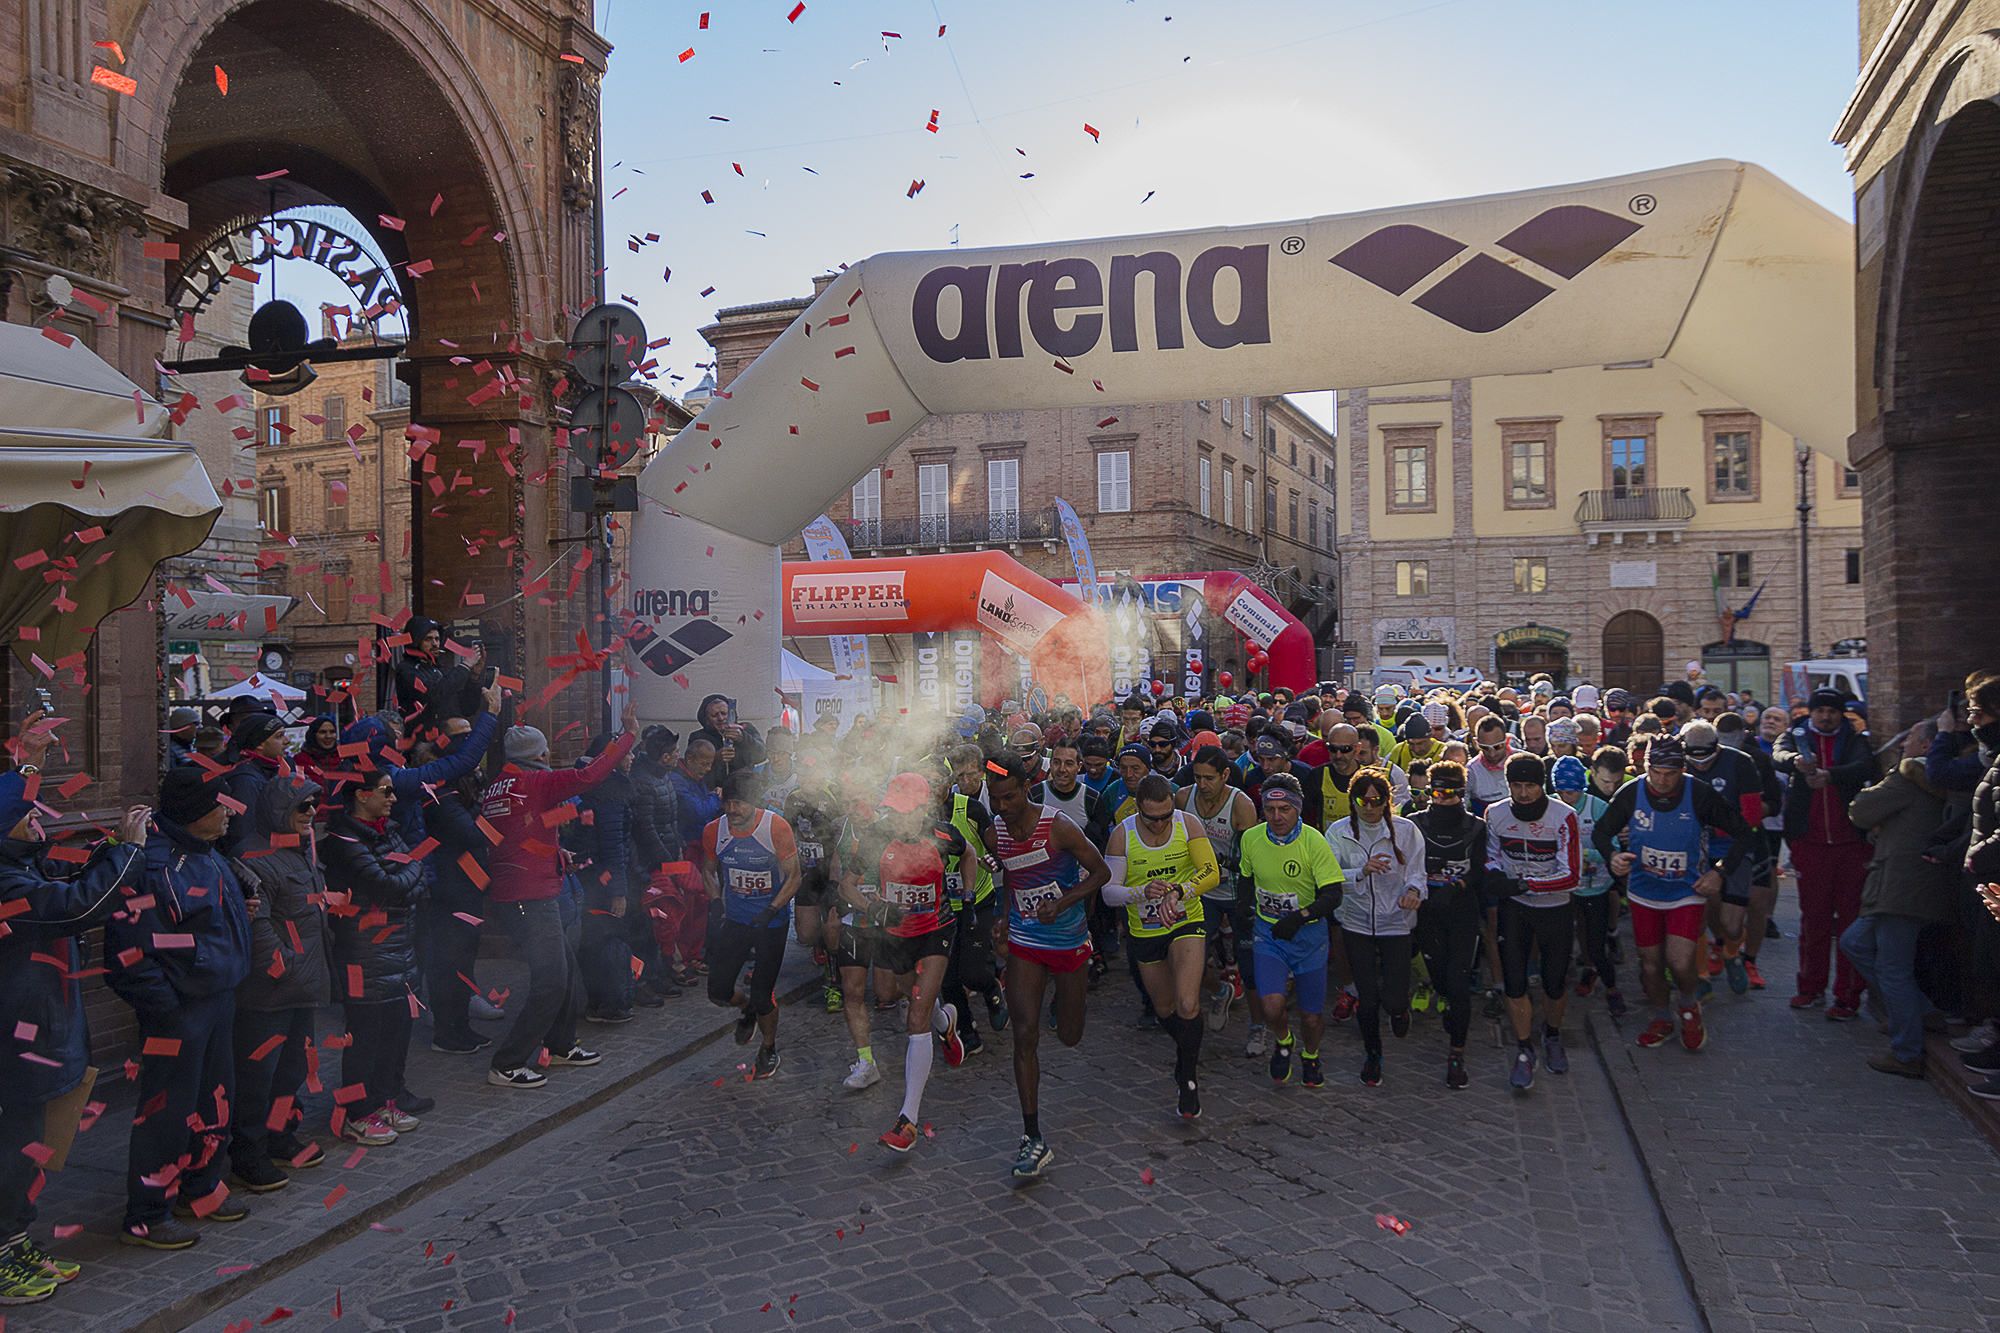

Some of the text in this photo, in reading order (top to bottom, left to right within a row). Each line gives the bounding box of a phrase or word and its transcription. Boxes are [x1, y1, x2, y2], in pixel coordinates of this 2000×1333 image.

[912, 244, 1272, 364] arena
[792, 585, 903, 602] FLIPPER
[634, 589, 709, 616] arena
[793, 602, 904, 610] TRIATHLON
[1230, 606, 1272, 643] Tolentino
[1237, 598, 1279, 635] Comunale
[955, 640, 974, 709] arena
[815, 698, 842, 715] arena
[486, 779, 515, 799] STAFF
[1648, 855, 1681, 870] 314
[1147, 866, 1177, 878] AVIS
[735, 876, 766, 889] 156
[895, 890, 930, 904] 138
[1263, 896, 1294, 911] 254
